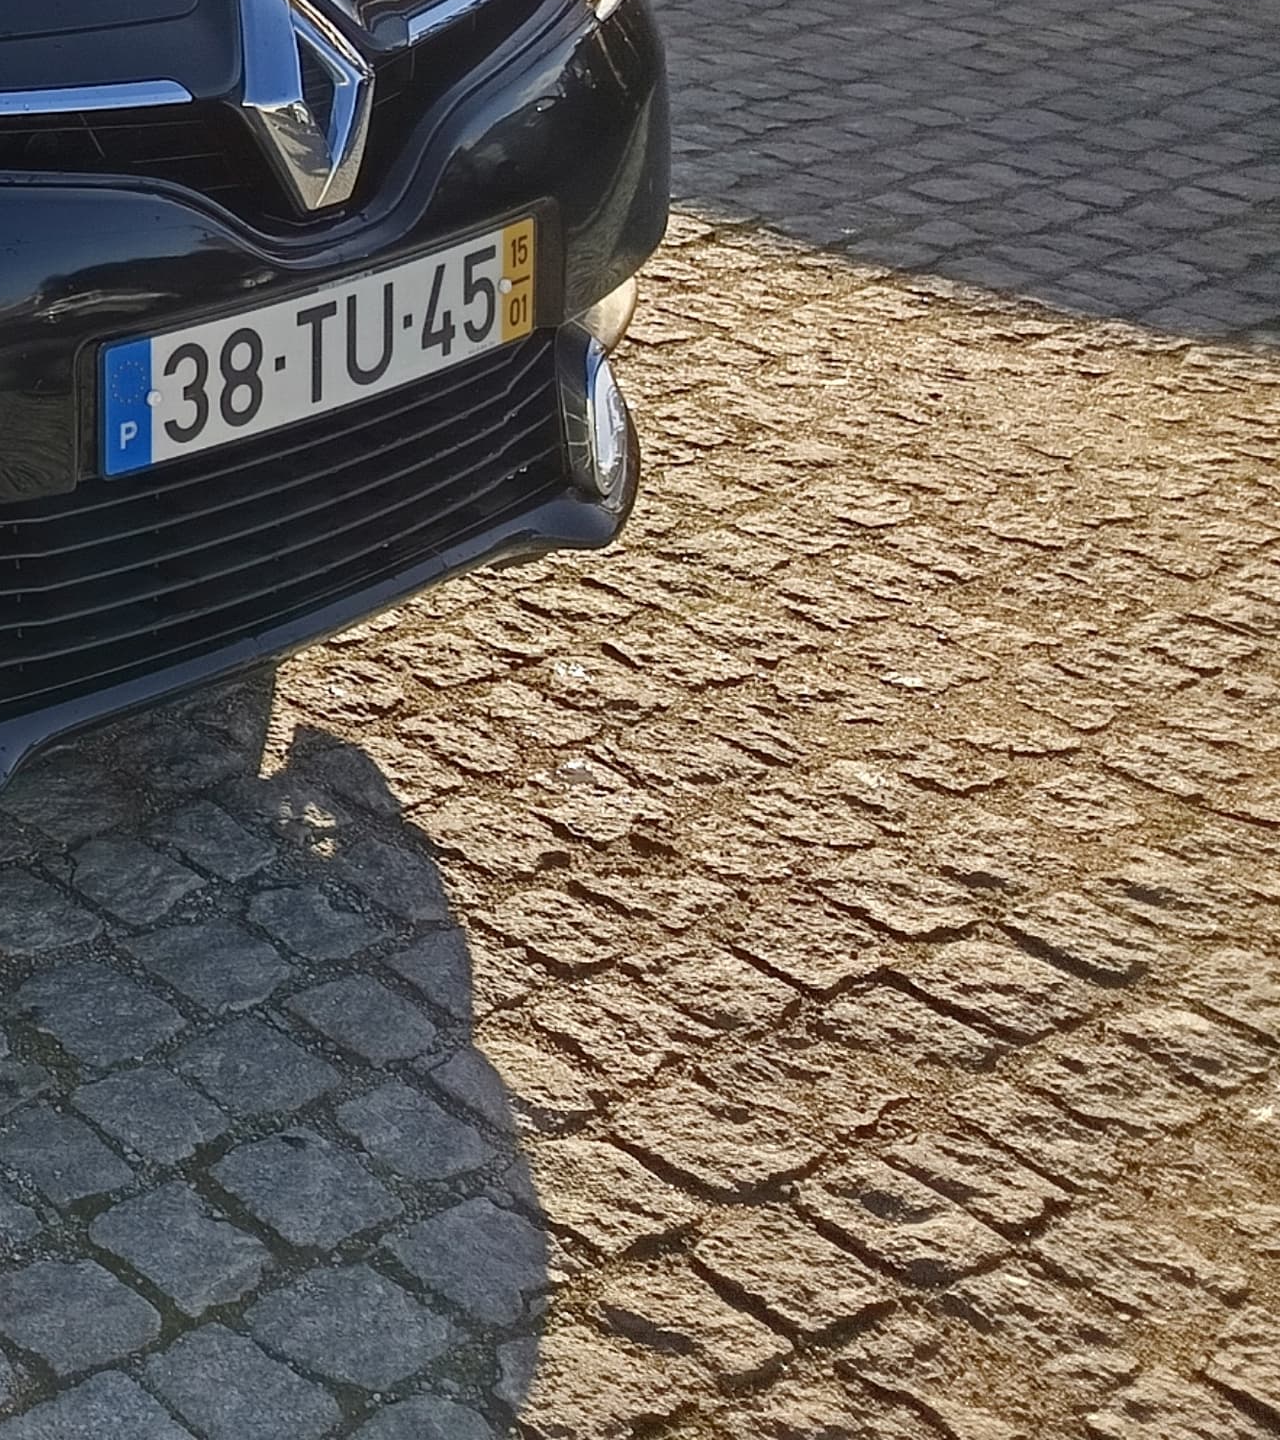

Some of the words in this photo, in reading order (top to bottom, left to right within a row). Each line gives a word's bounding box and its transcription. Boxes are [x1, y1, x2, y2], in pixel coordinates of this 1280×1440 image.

[510, 235, 529, 268] 15
[508, 299, 527, 328] 01
[120, 422, 138, 450] P
